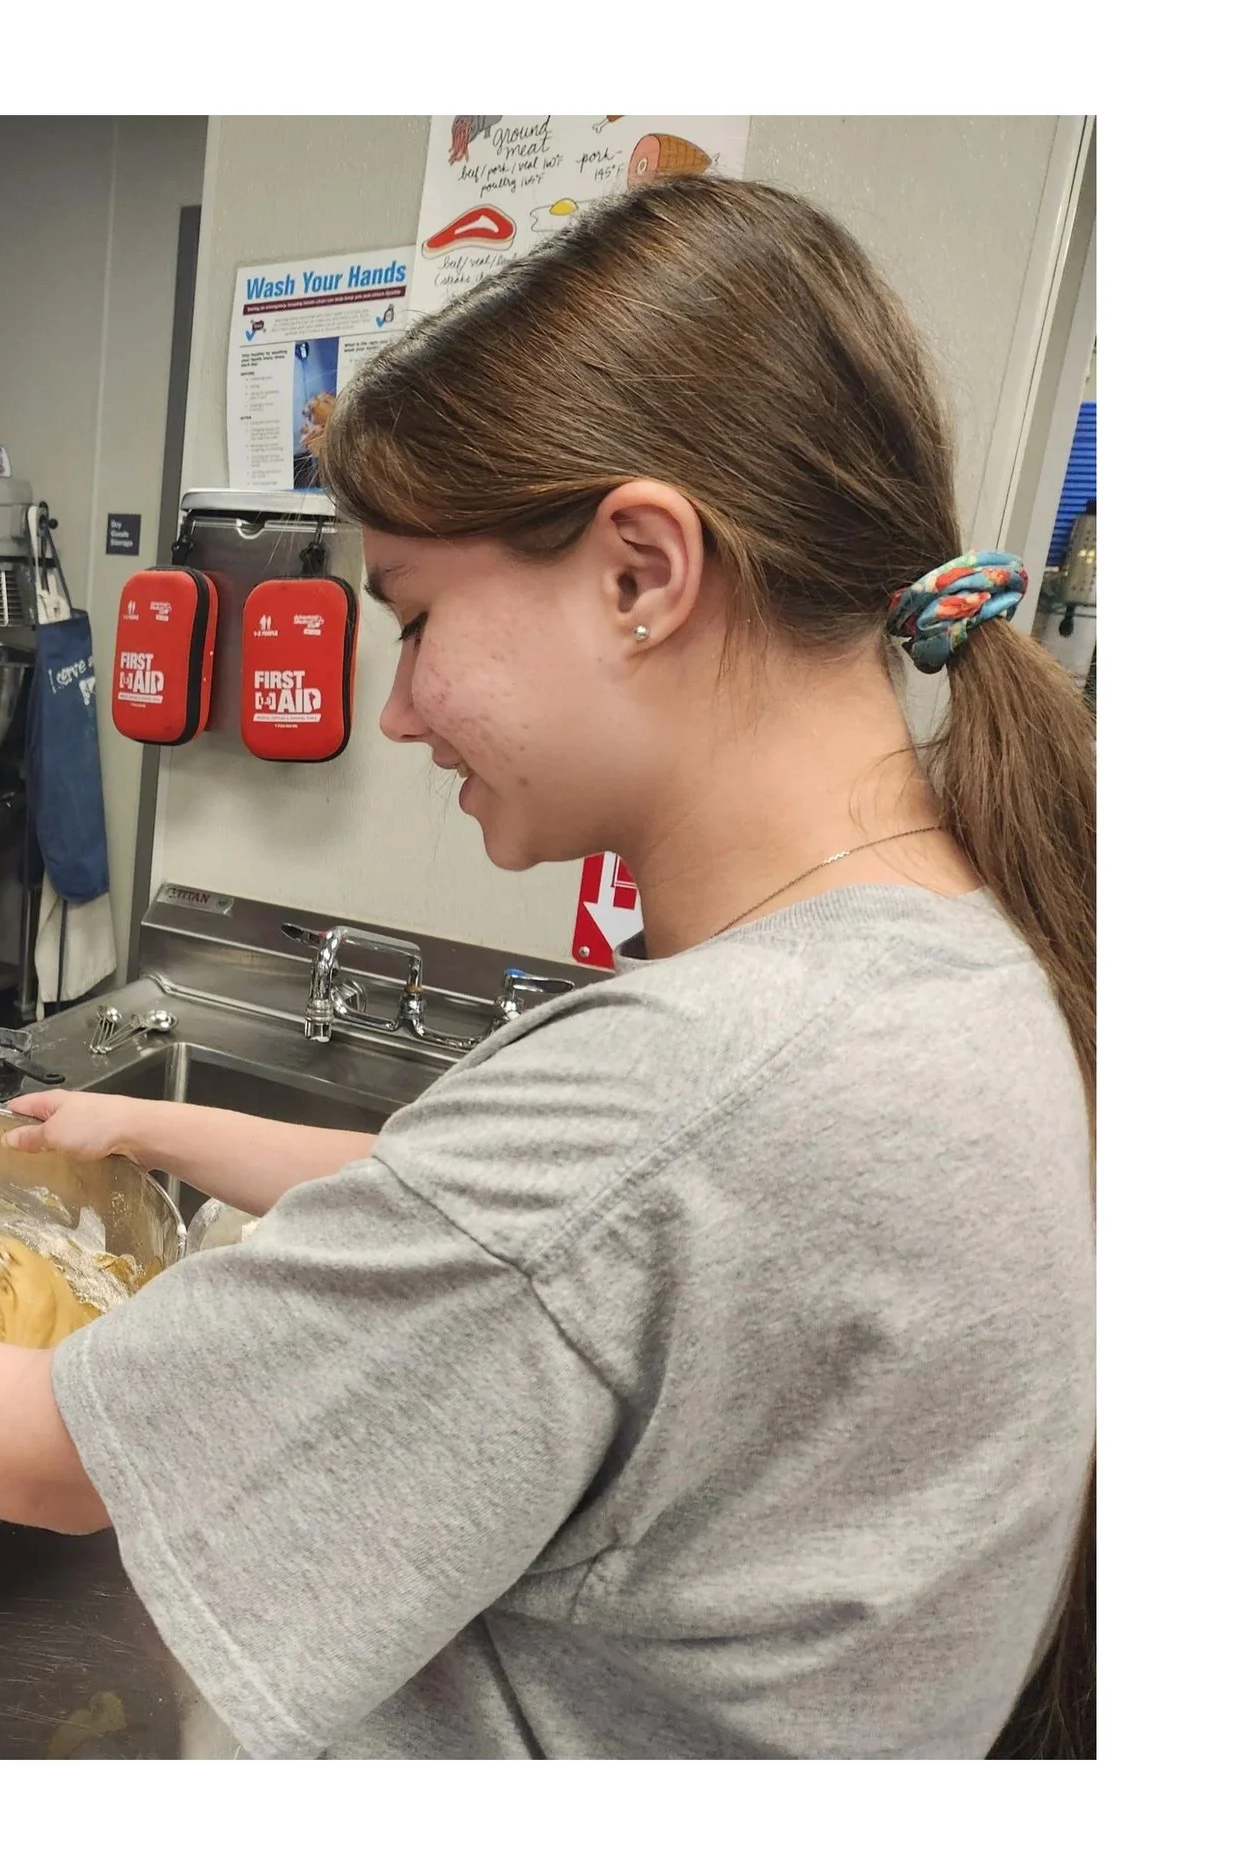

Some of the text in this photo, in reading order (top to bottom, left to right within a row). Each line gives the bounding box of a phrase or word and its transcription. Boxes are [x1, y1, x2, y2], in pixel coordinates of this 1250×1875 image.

[492, 115, 552, 156] ground
[506, 137, 552, 159] meat
[480, 177, 516, 198] poultry
[246, 260, 407, 300] Wash Your Hands
[120, 651, 154, 671] FIRST
[133, 670, 165, 695] AID
[254, 670, 305, 689] FIRST
[277, 688, 322, 713] AID
